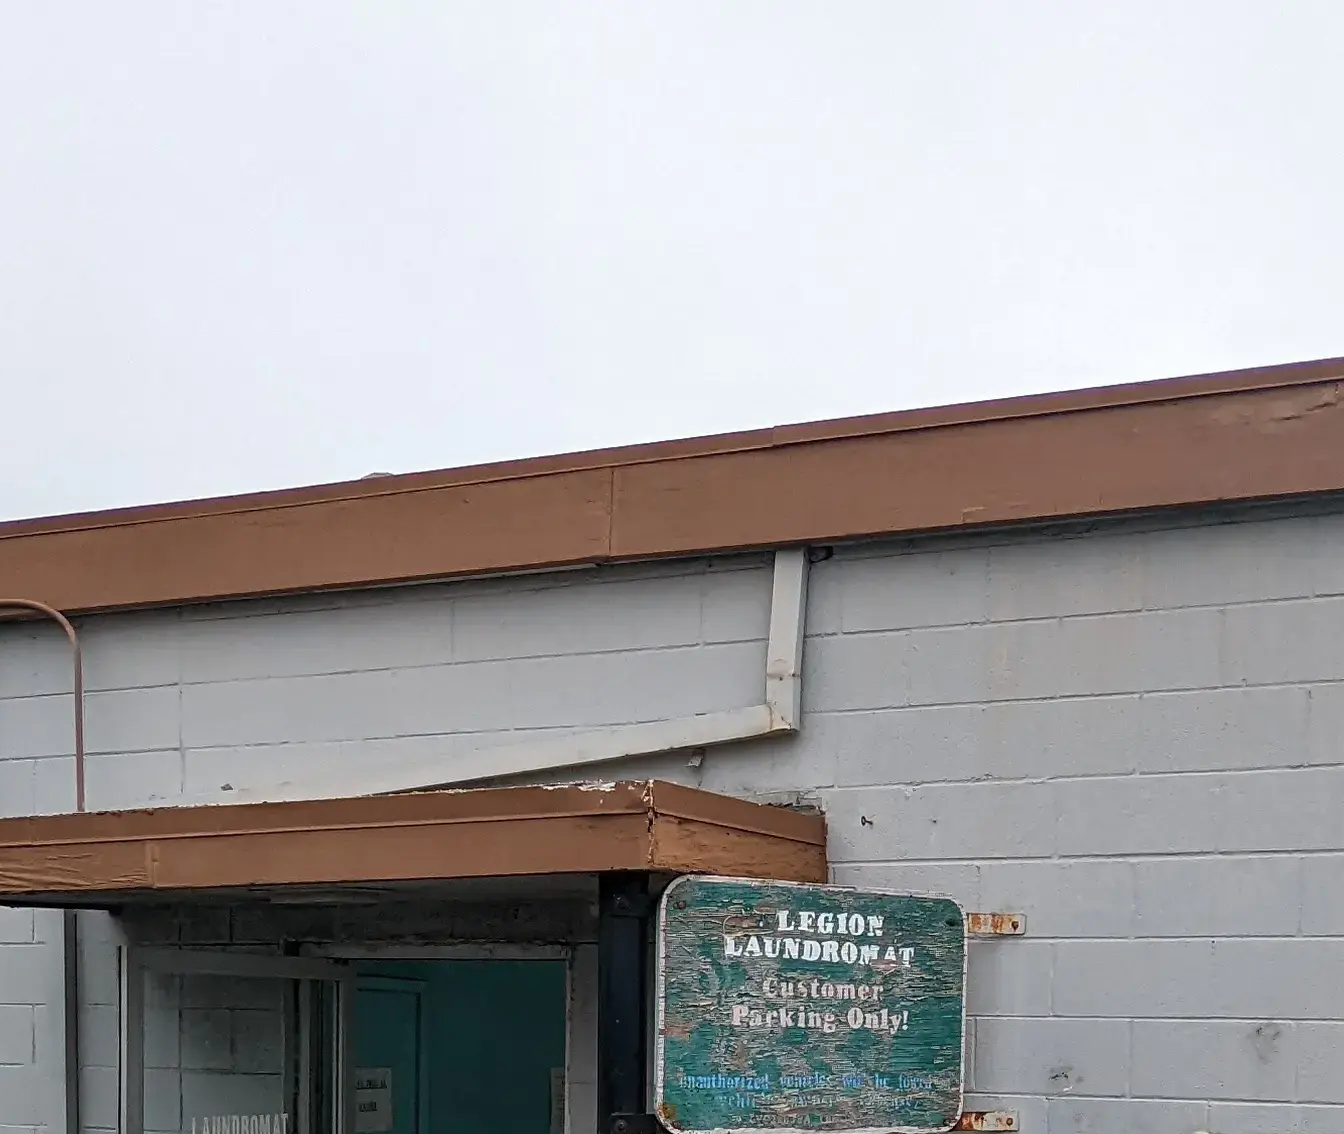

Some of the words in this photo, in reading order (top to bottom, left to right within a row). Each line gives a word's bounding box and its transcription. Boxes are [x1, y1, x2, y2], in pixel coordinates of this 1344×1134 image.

[776, 910, 885, 937] LEGION
[724, 936, 915, 968] LAUNDROMAT
[762, 977, 884, 1001] Customer
[730, 1006, 836, 1033] Parking
[847, 1006, 910, 1035] Only!
